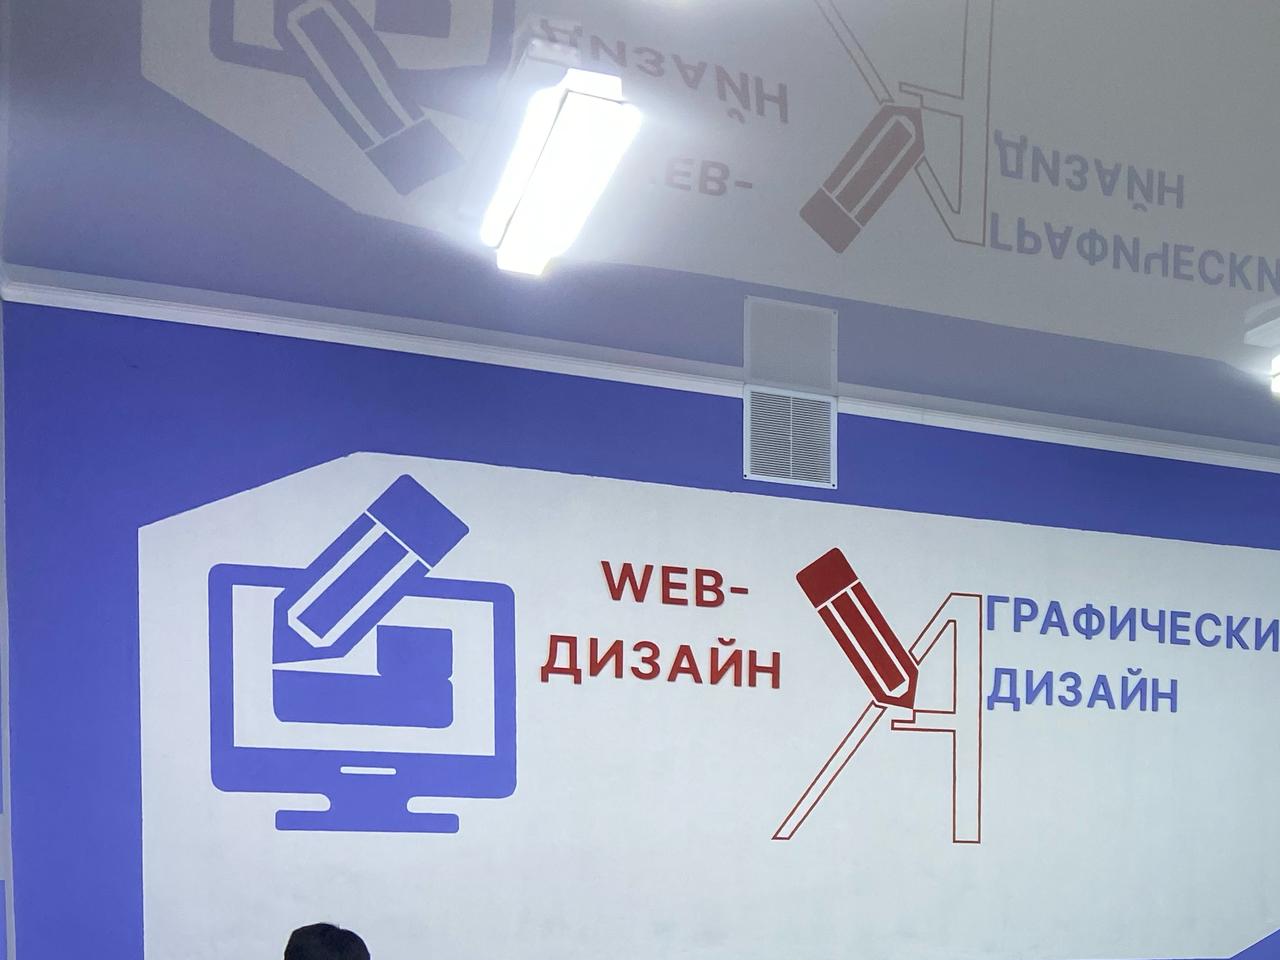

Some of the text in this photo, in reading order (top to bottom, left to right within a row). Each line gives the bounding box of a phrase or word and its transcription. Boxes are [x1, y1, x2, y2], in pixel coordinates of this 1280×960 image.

[600, 559, 748, 608] WEB-
[540, 633, 782, 690] ДИЗАЙН
[987, 665, 1179, 715] ДИЗАЙН
